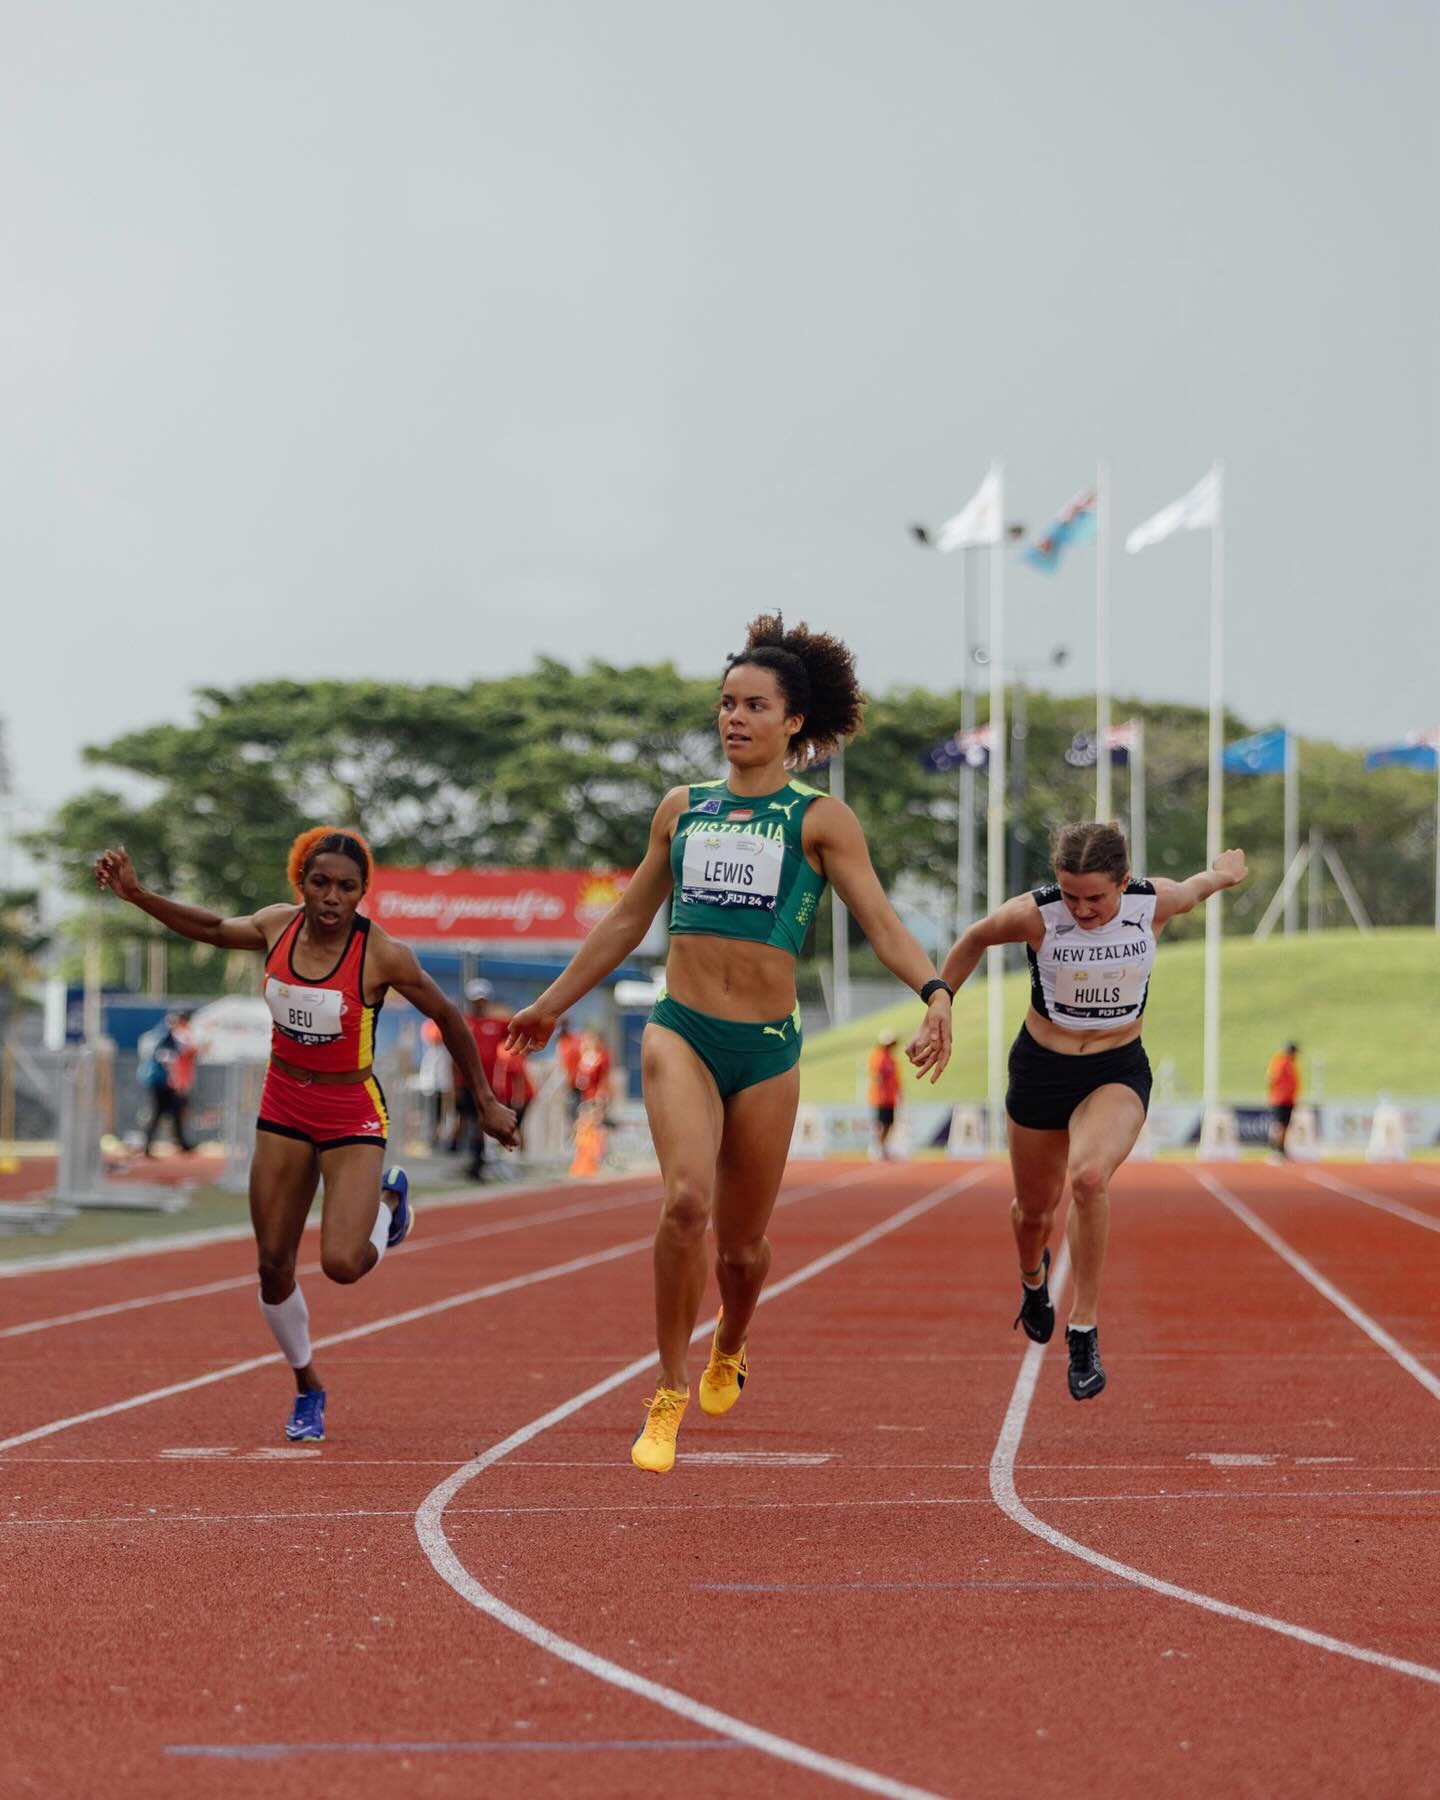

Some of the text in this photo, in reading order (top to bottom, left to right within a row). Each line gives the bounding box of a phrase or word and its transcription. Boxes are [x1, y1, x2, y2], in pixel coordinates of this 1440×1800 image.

[681, 821, 785, 843] AUSTRALIA
[704, 860, 754, 886] LEWIS
[726, 893, 746, 905] FIJI
[748, 896, 762, 906] 24
[1053, 942, 1147, 962] NEW ZEALAND
[1075, 987, 1120, 1003] HULLS
[288, 1008, 312, 1028] BEU
[1098, 1009, 1114, 1017] FIJI
